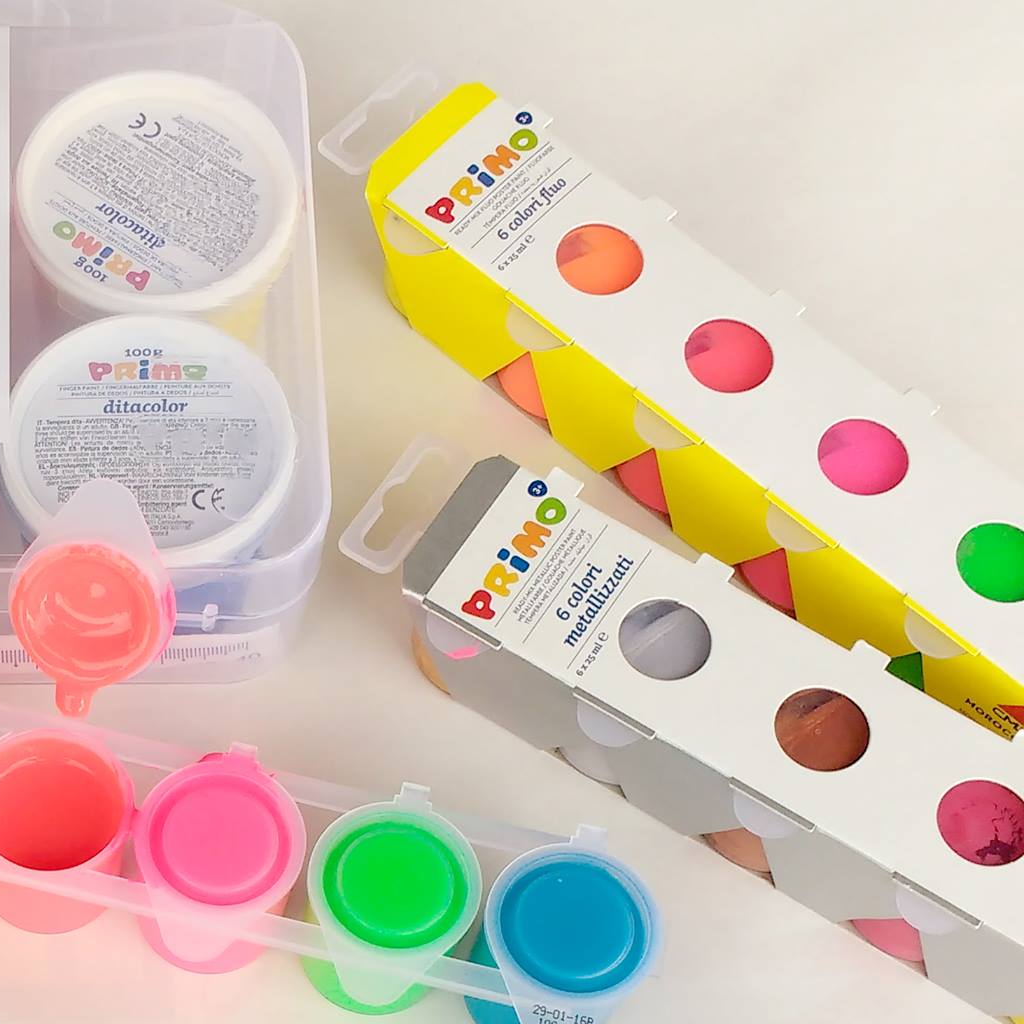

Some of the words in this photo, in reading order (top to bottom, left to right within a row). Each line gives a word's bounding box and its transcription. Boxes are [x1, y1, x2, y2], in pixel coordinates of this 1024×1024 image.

[95, 203, 167, 250] ditacolor
[497, 228, 509, 241] 6
[508, 196, 544, 232] colori
[540, 178, 567, 207] fluo
[498, 264, 505, 272] 6
[103, 399, 188, 414] ditacolor
[556, 607, 570, 621] 6
[570, 563, 603, 608] colori
[563, 554, 634, 648] metallizzati
[592, 642, 603, 655] ml
[965, 698, 1014, 739] MOROC
